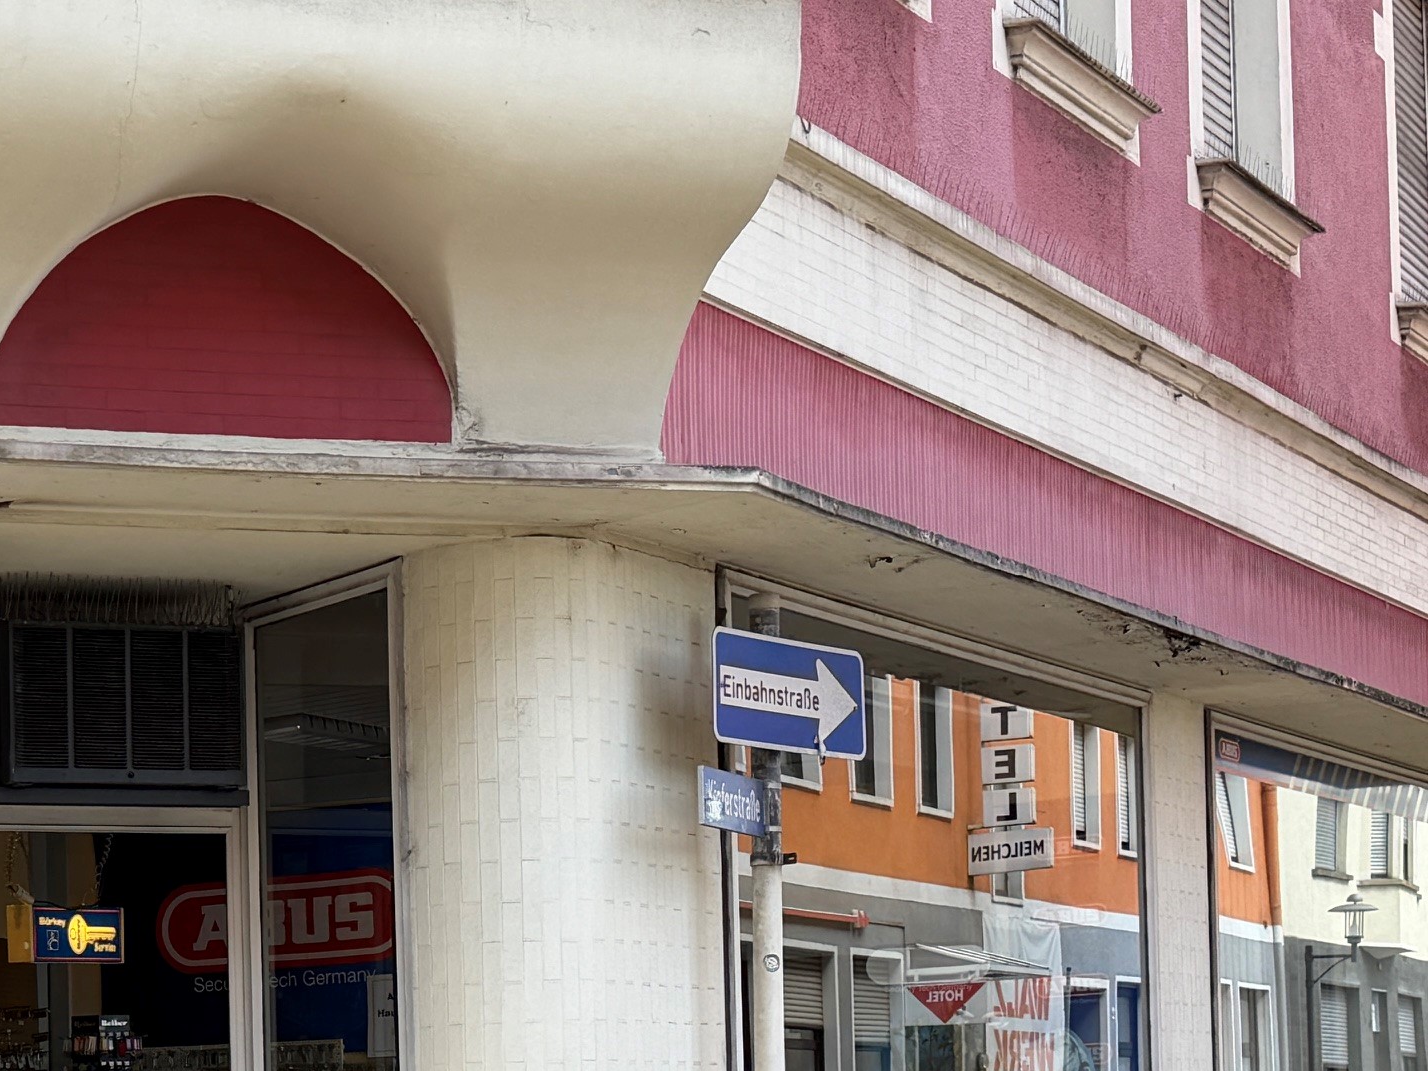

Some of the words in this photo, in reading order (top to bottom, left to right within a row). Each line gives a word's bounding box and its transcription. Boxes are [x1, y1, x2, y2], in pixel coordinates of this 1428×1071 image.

[722, 674, 820, 711] Einbahnstraße
[269, 971, 297, 988] ech
[302, 968, 377, 988] Germany
